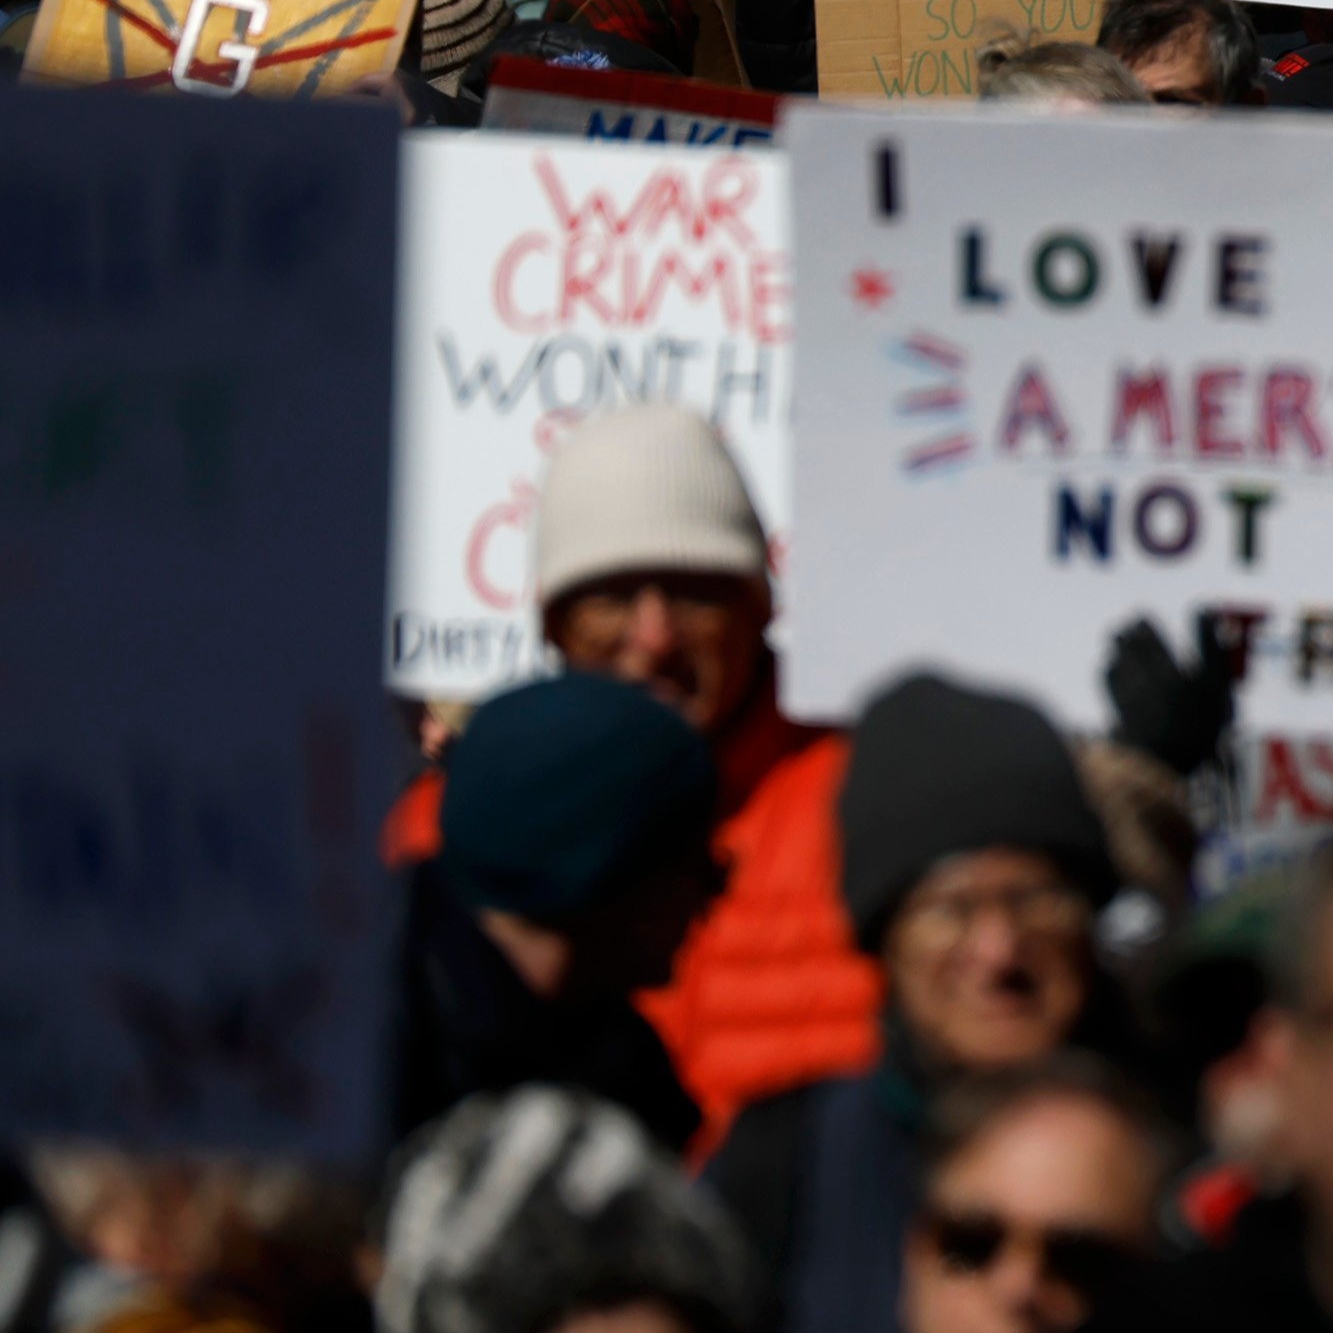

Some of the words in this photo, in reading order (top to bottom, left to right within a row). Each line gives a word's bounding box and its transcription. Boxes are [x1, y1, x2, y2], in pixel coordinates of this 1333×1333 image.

[532, 148, 764, 253] WAR
[872, 138, 903, 221] I
[490, 226, 793, 347] CRIME
[955, 223, 1273, 317] LOVE
[1051, 478, 1277, 568] NOT
